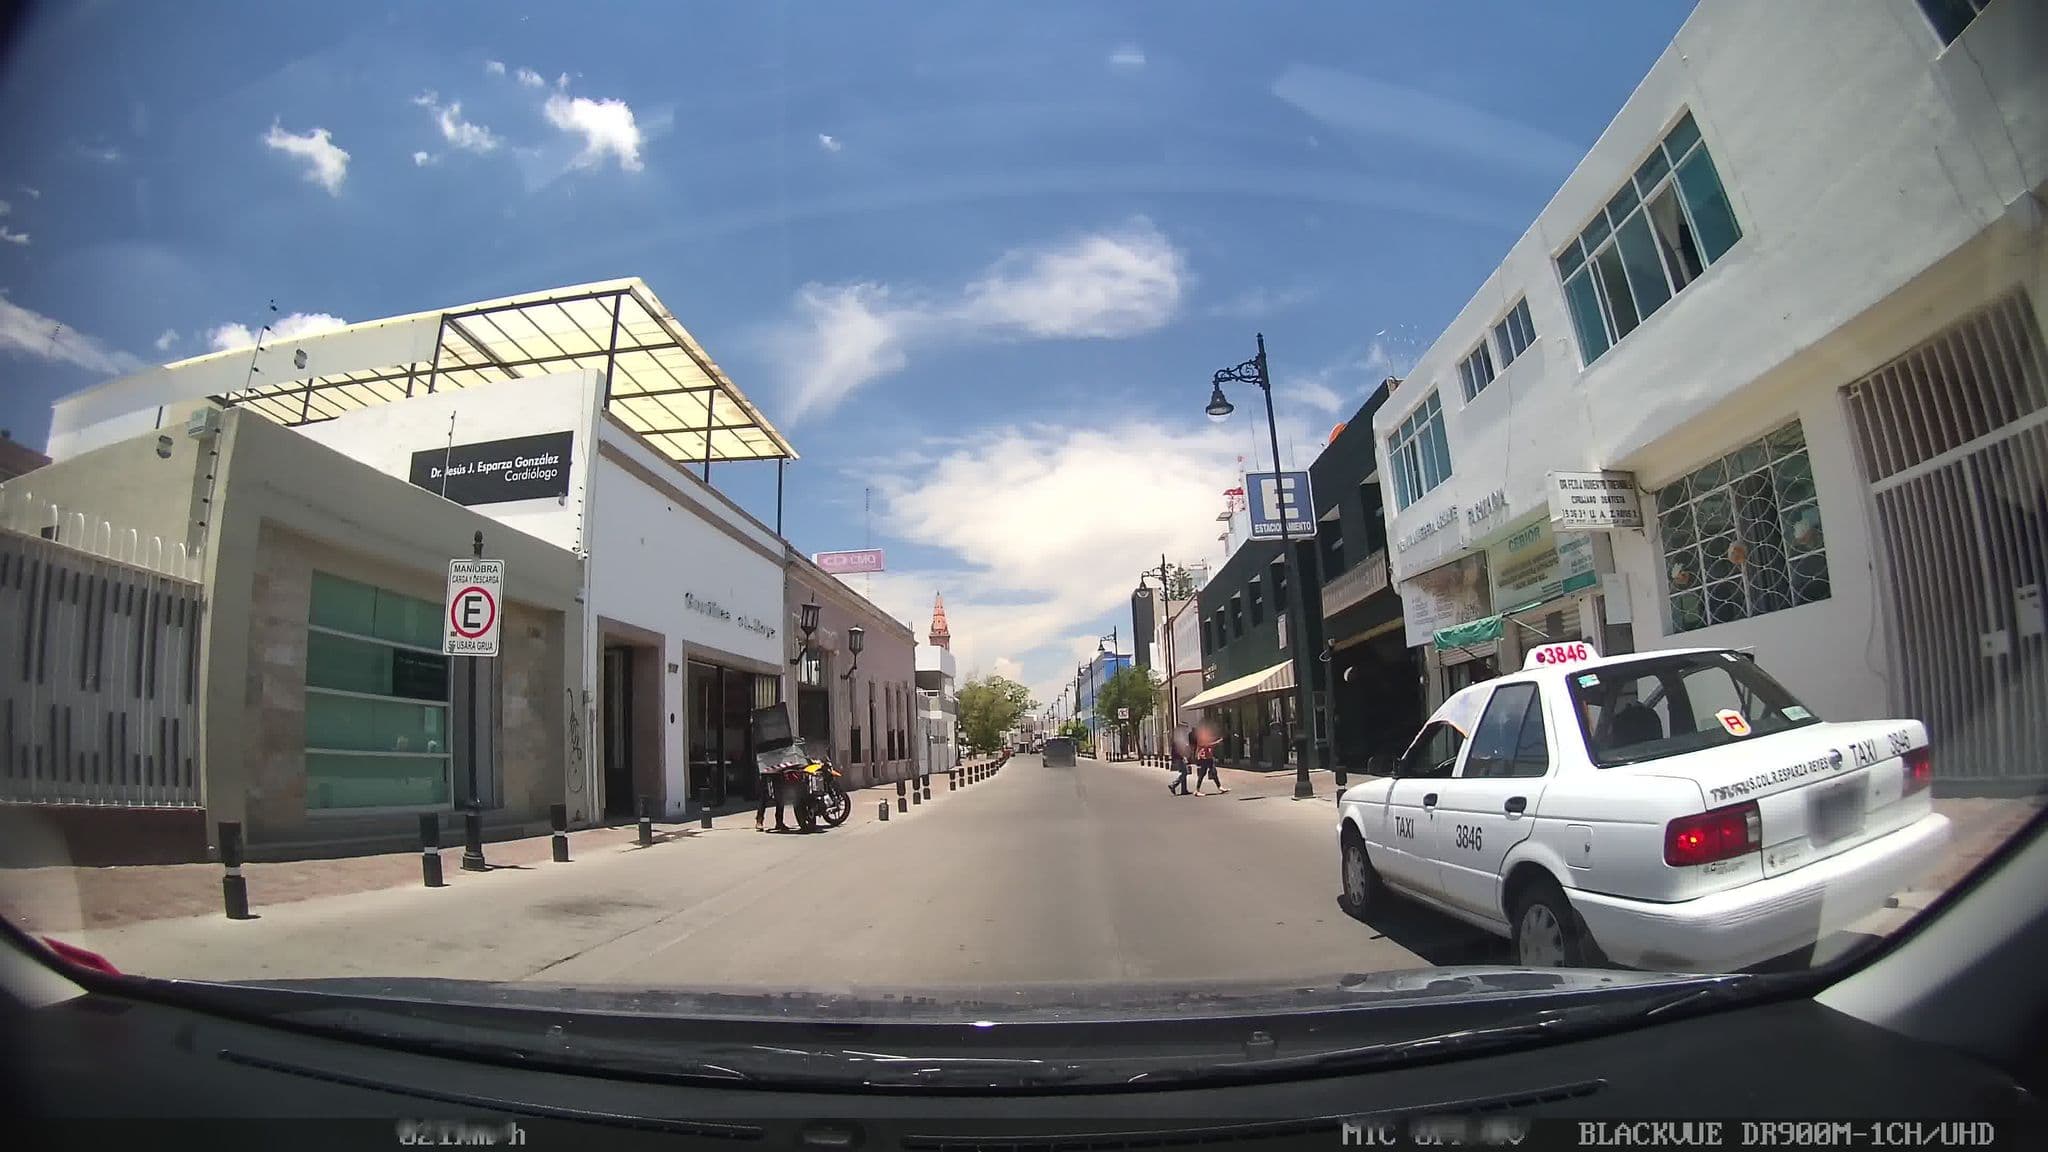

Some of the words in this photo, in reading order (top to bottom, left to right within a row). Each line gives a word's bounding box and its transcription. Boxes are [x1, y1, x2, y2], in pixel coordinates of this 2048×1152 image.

[431, 467, 442, 478] Dr.
[467, 462, 475, 474] J.
[478, 460, 512, 475] Esparza
[515, 453, 559, 468] González
[505, 468, 558, 482] Cardiólogo
[1261, 477, 1299, 520] E
[454, 565, 498, 574] MANIOBRA
[463, 596, 482, 628] E
[456, 640, 476, 651] USARA
[1545, 644, 1588, 665] 3846
[1847, 738, 1877, 767] TAXI
[1888, 729, 1911, 755] 3846
[1808, 757, 1828, 773] REYES
[1395, 815, 1415, 839] TAXI
[1455, 824, 1483, 852] 3846
